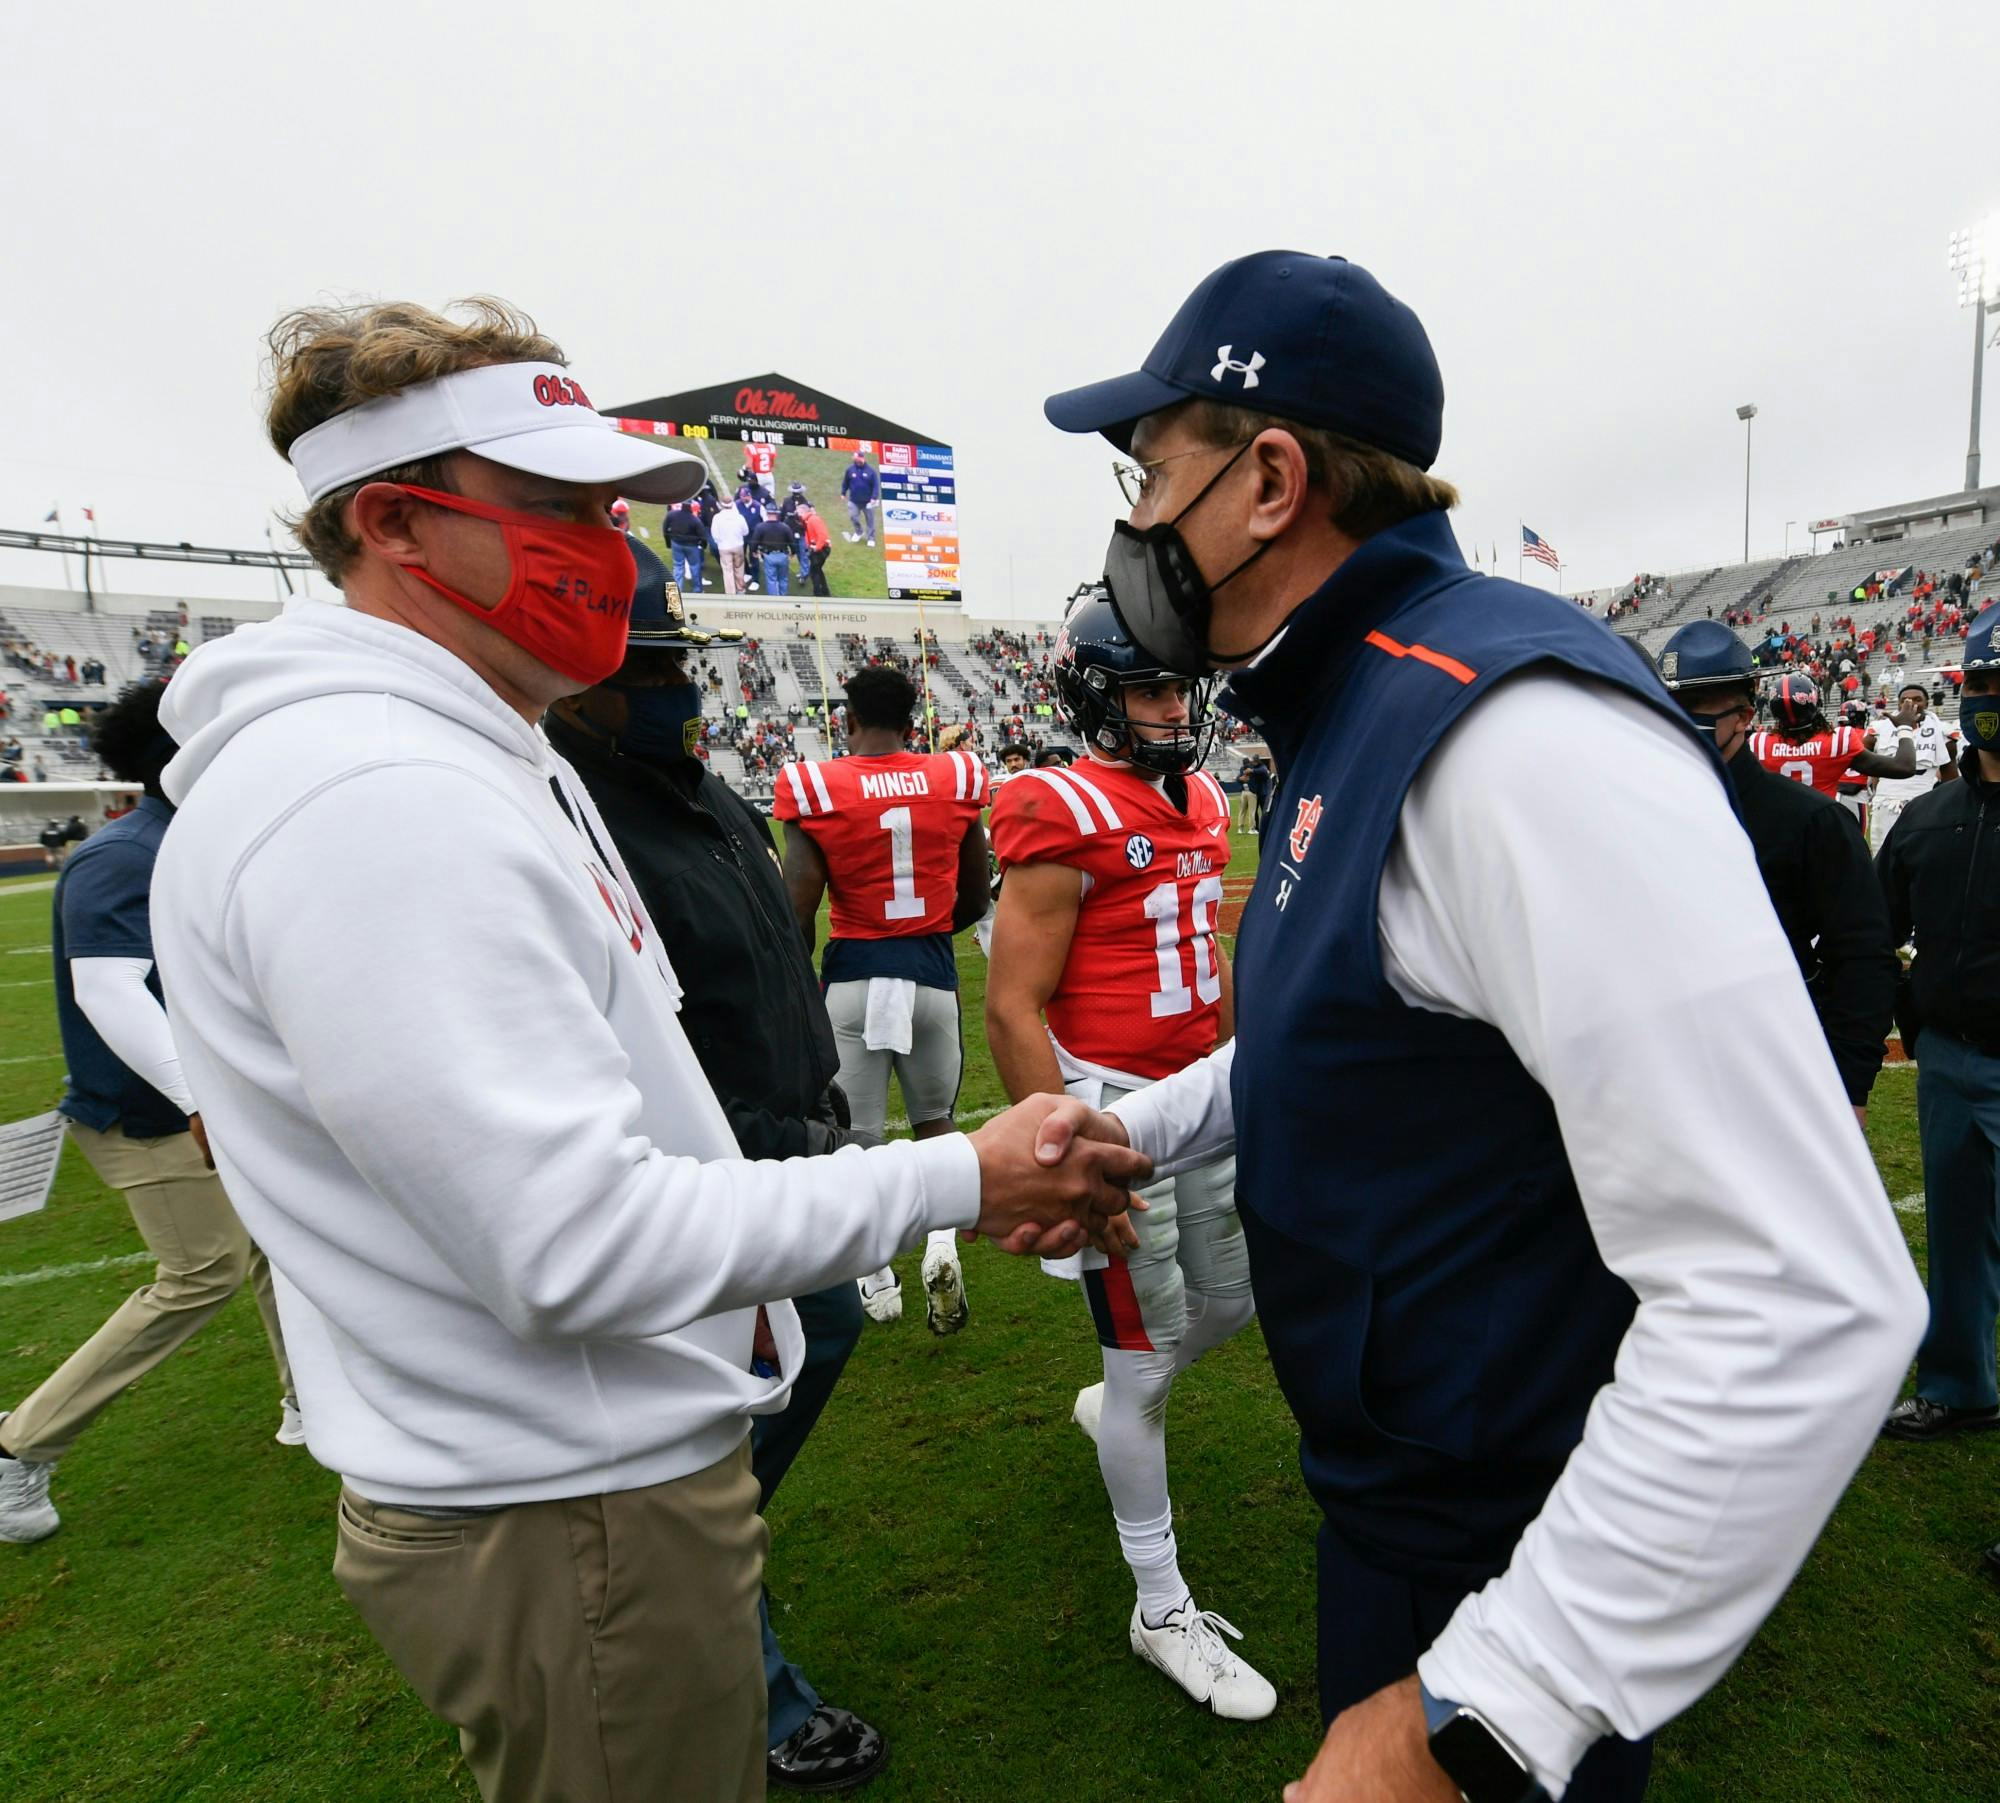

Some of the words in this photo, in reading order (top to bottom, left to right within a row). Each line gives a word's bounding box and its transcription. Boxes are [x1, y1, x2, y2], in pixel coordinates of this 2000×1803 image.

[533, 374, 574, 407] Ole
[734, 387, 768, 416] Ole
[766, 389, 820, 420] Miss
[683, 424, 709, 439] 0:00
[708, 414, 739, 425] JERRY
[741, 418, 820, 432] HOLLINGSWORTH
[822, 425, 847, 435] FIELD
[752, 430, 766, 443] ON
[766, 431, 784, 444] THE
[921, 511, 953, 523] FedEx
[927, 569, 957, 578] SONIC
[723, 611, 753, 620] JERRY
[842, 614, 867, 622] FIELD
[1772, 741, 1822, 757] GREGORY
[860, 771, 929, 799] MINGO
[879, 806, 926, 920] 1
[1126, 834, 1154, 869] SEC
[1176, 852, 1193, 878] Ole
[1191, 850, 1212, 875] Miss
[1143, 876, 1224, 1018] 10
